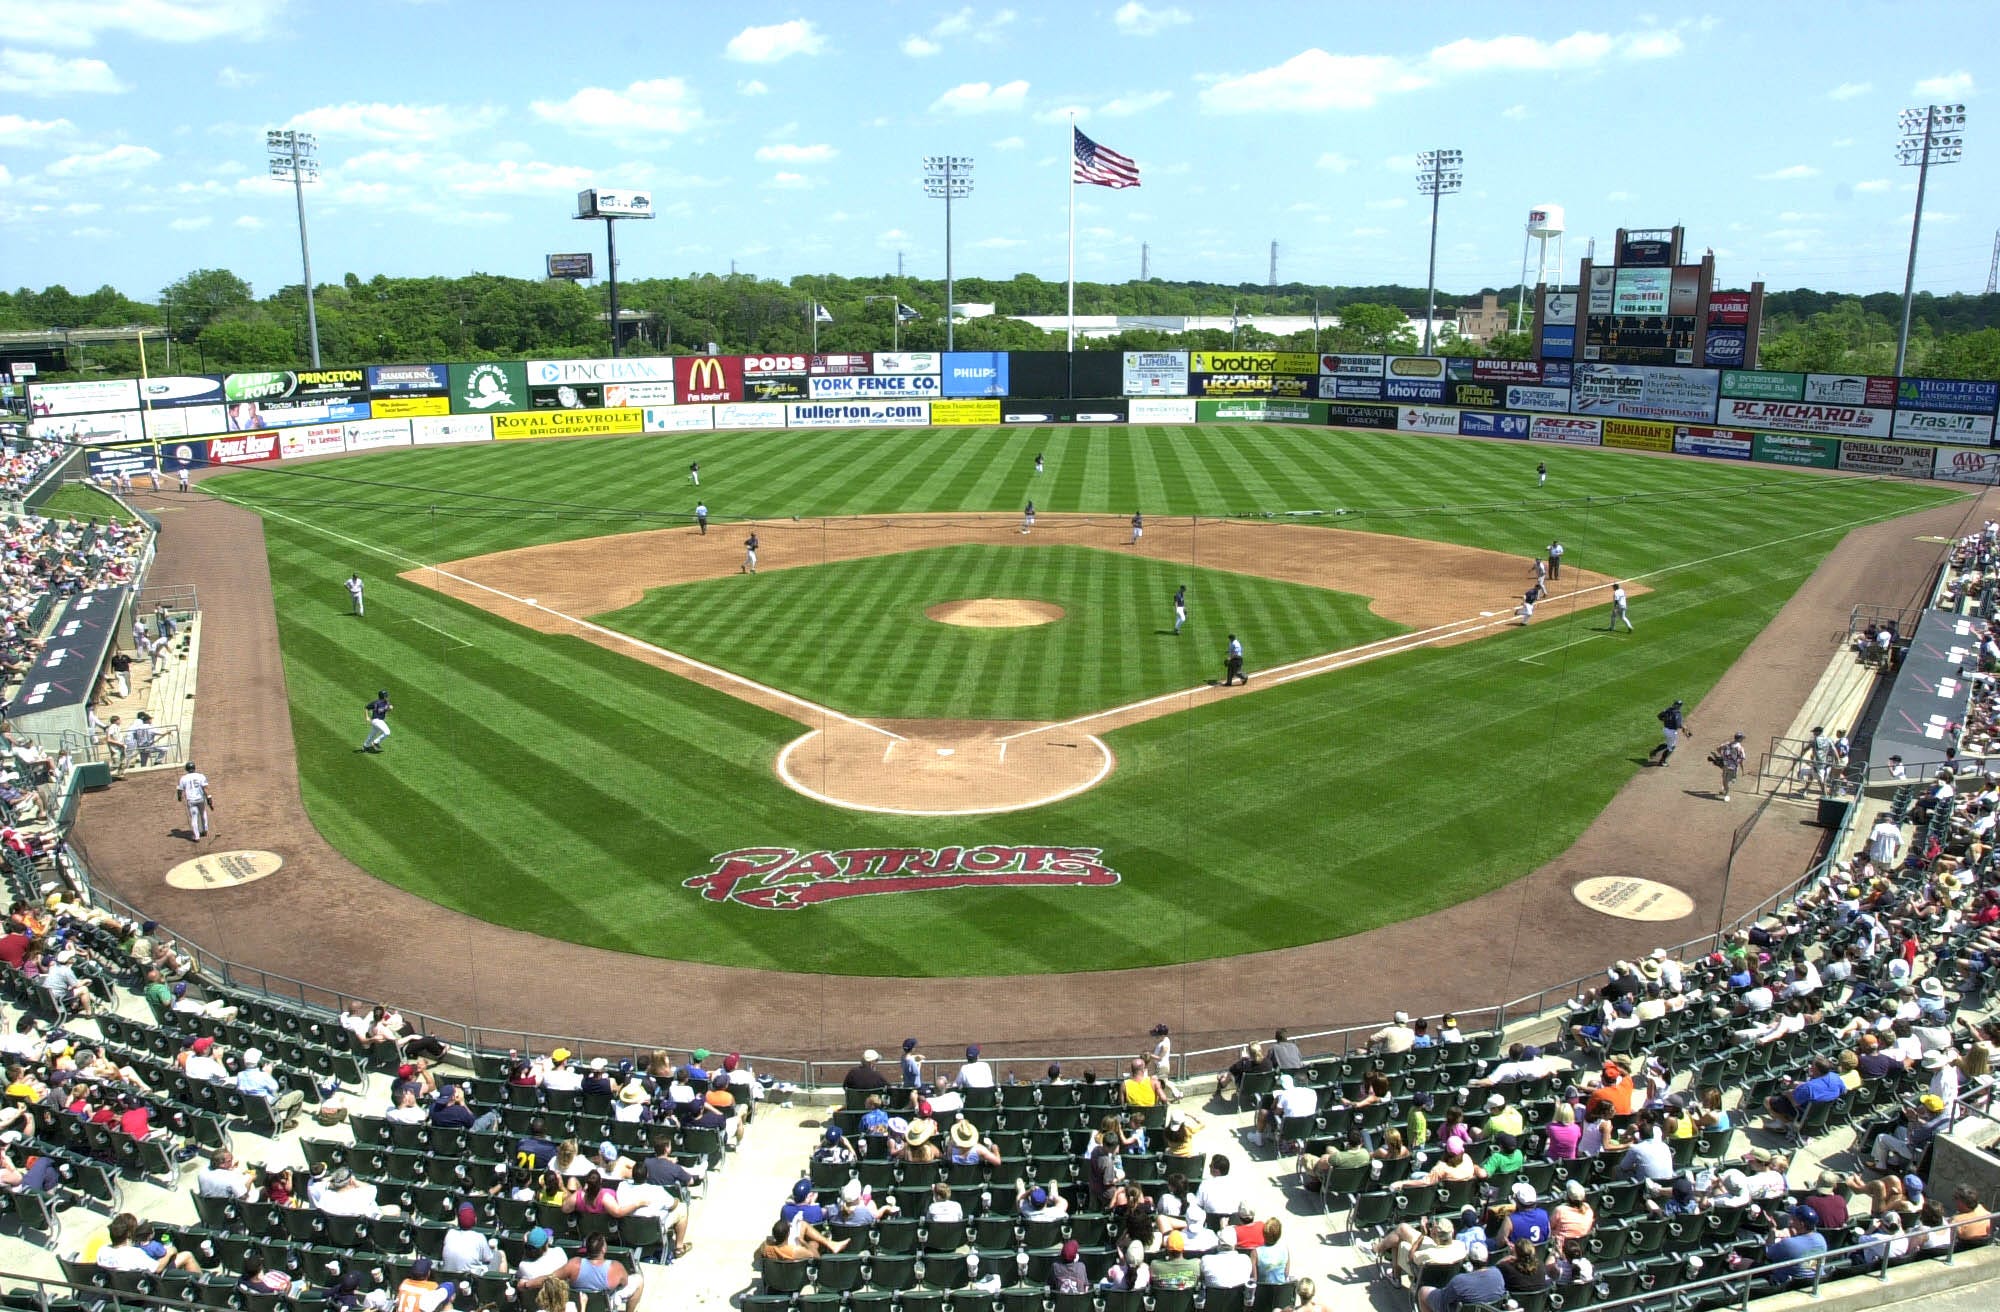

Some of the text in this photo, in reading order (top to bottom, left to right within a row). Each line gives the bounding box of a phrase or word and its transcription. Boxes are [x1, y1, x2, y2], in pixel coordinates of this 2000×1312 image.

[1714, 338, 1740, 347] BUD
[1705, 346, 1742, 355] LIGHT
[744, 356, 806, 371] PODS
[1138, 355, 1177, 366] LUMBER
[1211, 356, 1278, 371] brother
[1477, 360, 1539, 373] DRUG FAIR
[298, 370, 363, 384] PRINCETON
[564, 364, 606, 380] PNC
[953, 367, 997, 378] PHILIPS
[238, 374, 272, 387] LAND
[812, 377, 853, 391] YORK
[858, 377, 905, 390] FENCE
[912, 377, 939, 390] CO.
[1583, 374, 1643, 388] Flemington
[1919, 380, 1996, 395] HIGH TECH
[244, 381, 285, 399] ROVER
[1774, 385, 1798, 393] BANK
[1456, 394, 1494, 405] Honda
[1331, 406, 1395, 418] BRIDGEWATER
[1617, 402, 1710, 419] flemington.com
[1732, 401, 1759, 415] PC
[1762, 403, 1856, 422] RICHARD
[496, 412, 640, 428] ROYAL CHEVROLET
[1420, 412, 1456, 427] Sprint
[1535, 417, 1597, 430] REPS
[530, 425, 610, 435] BRIDGEWATER
[1606, 421, 1671, 439] SHANAHAN'S
[1712, 430, 1734, 439] SOLD
[1843, 441, 1931, 458] GENERAL CONTAINER
[1953, 452, 1984, 467] AAA
[683, 846, 1123, 910] PATRIOTS
[516, 1151, 535, 1170] 21
[1529, 1225, 1541, 1242] 3
